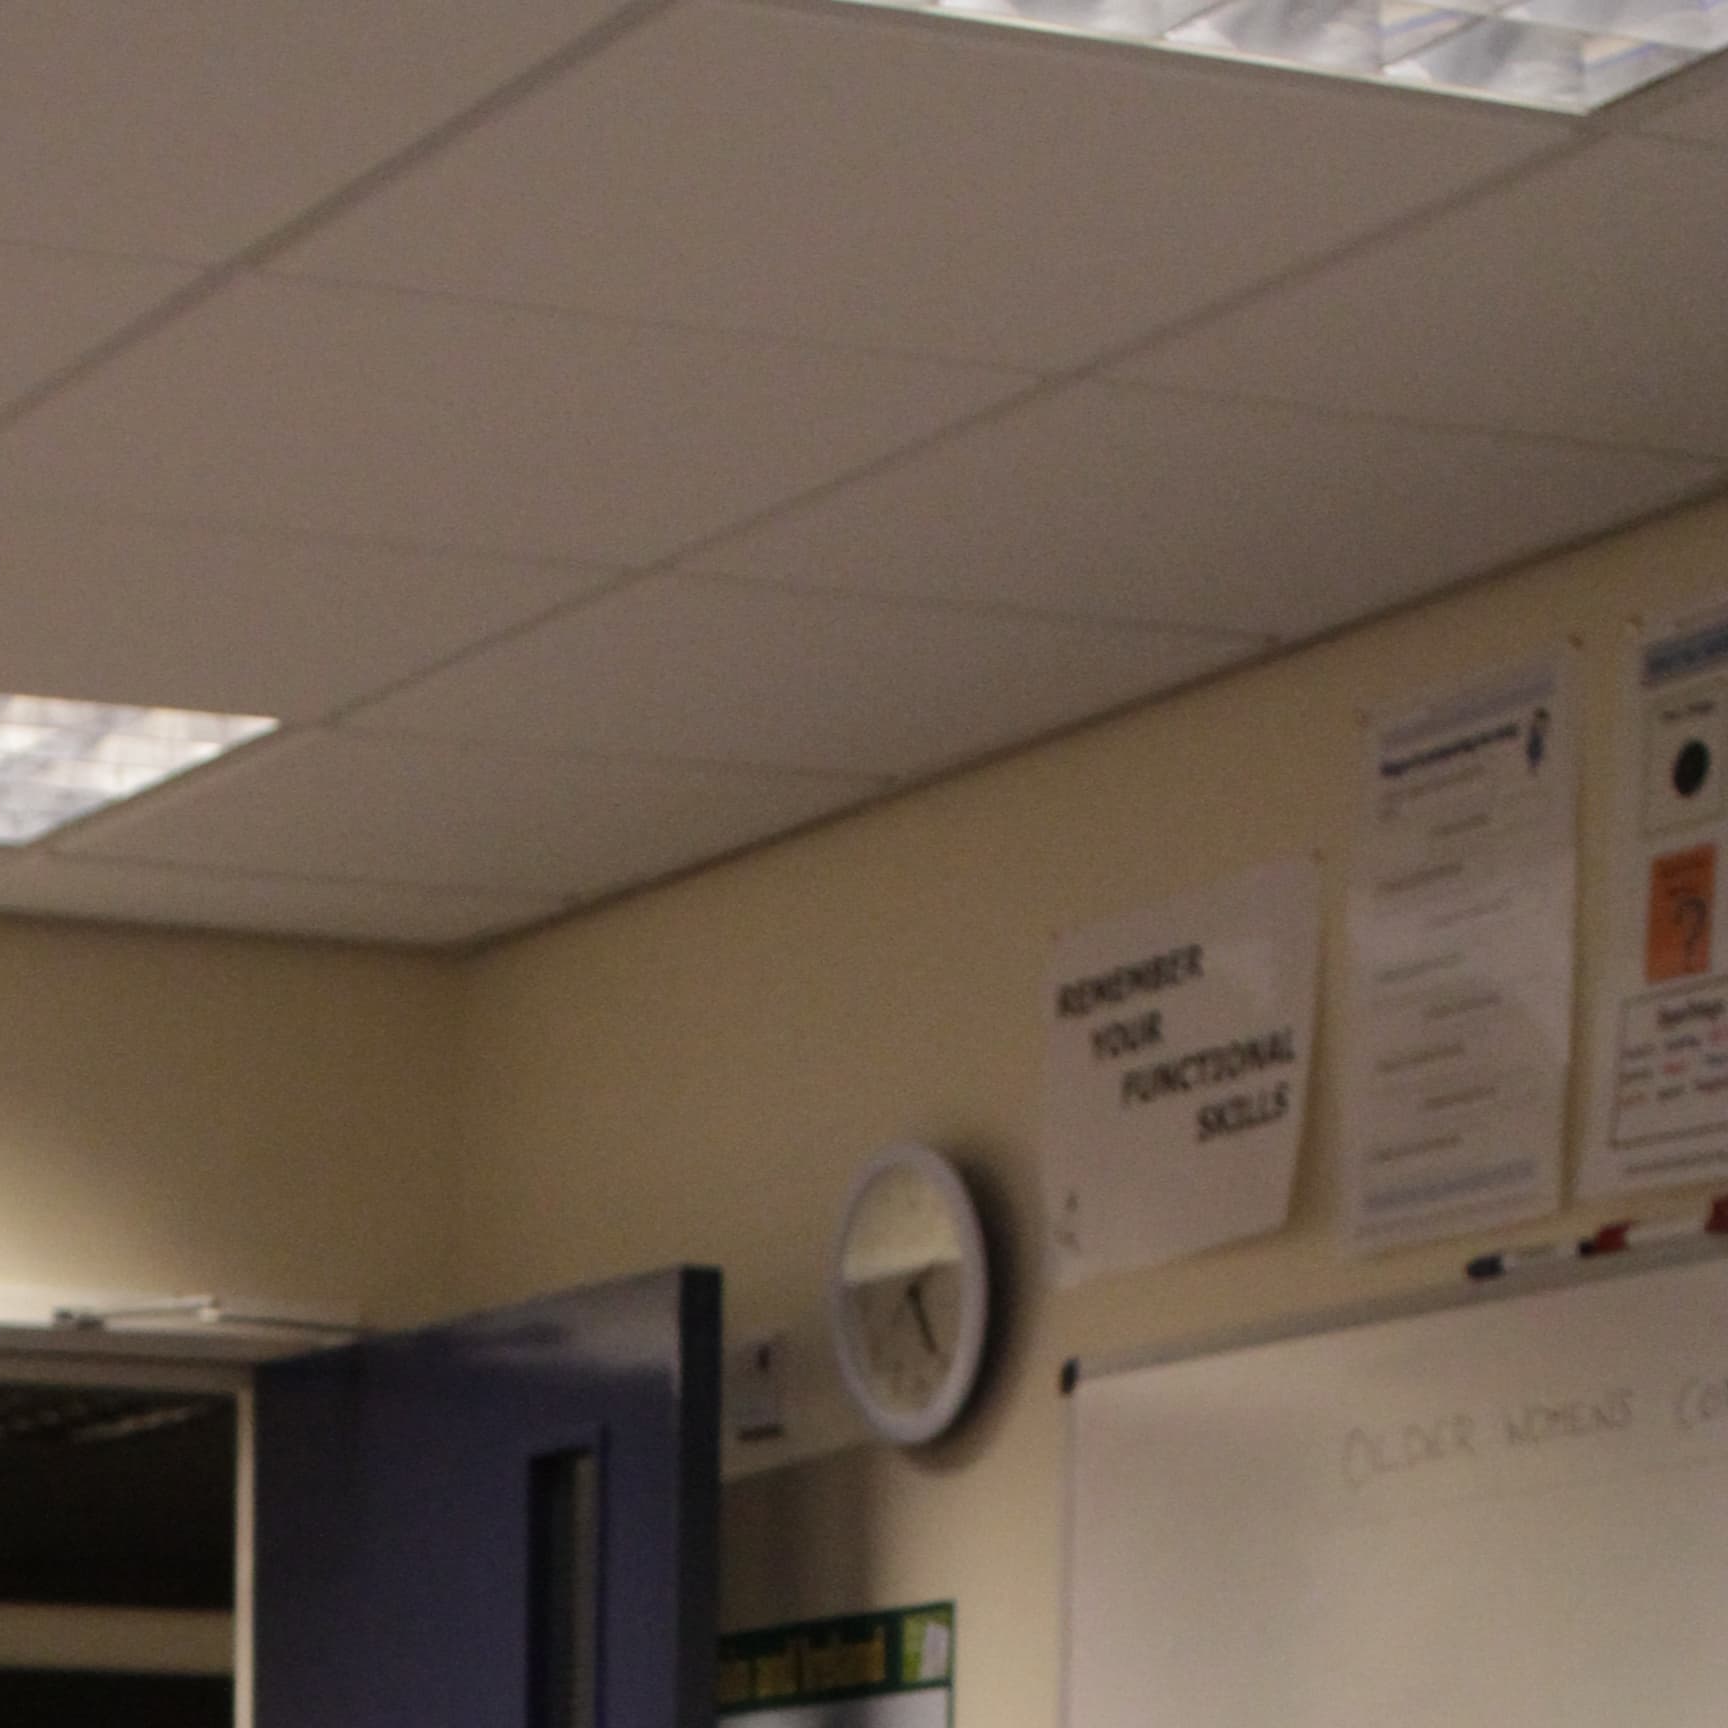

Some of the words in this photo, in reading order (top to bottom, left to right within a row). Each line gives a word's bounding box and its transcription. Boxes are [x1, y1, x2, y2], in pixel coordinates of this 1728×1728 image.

[1055, 943, 1205, 1018] REMEMBER
[1091, 1009, 1163, 1060] YOUR
[1121, 1028, 1295, 1108] FUNCTIONAL
[1197, 1081, 1290, 1143] SKILLS
